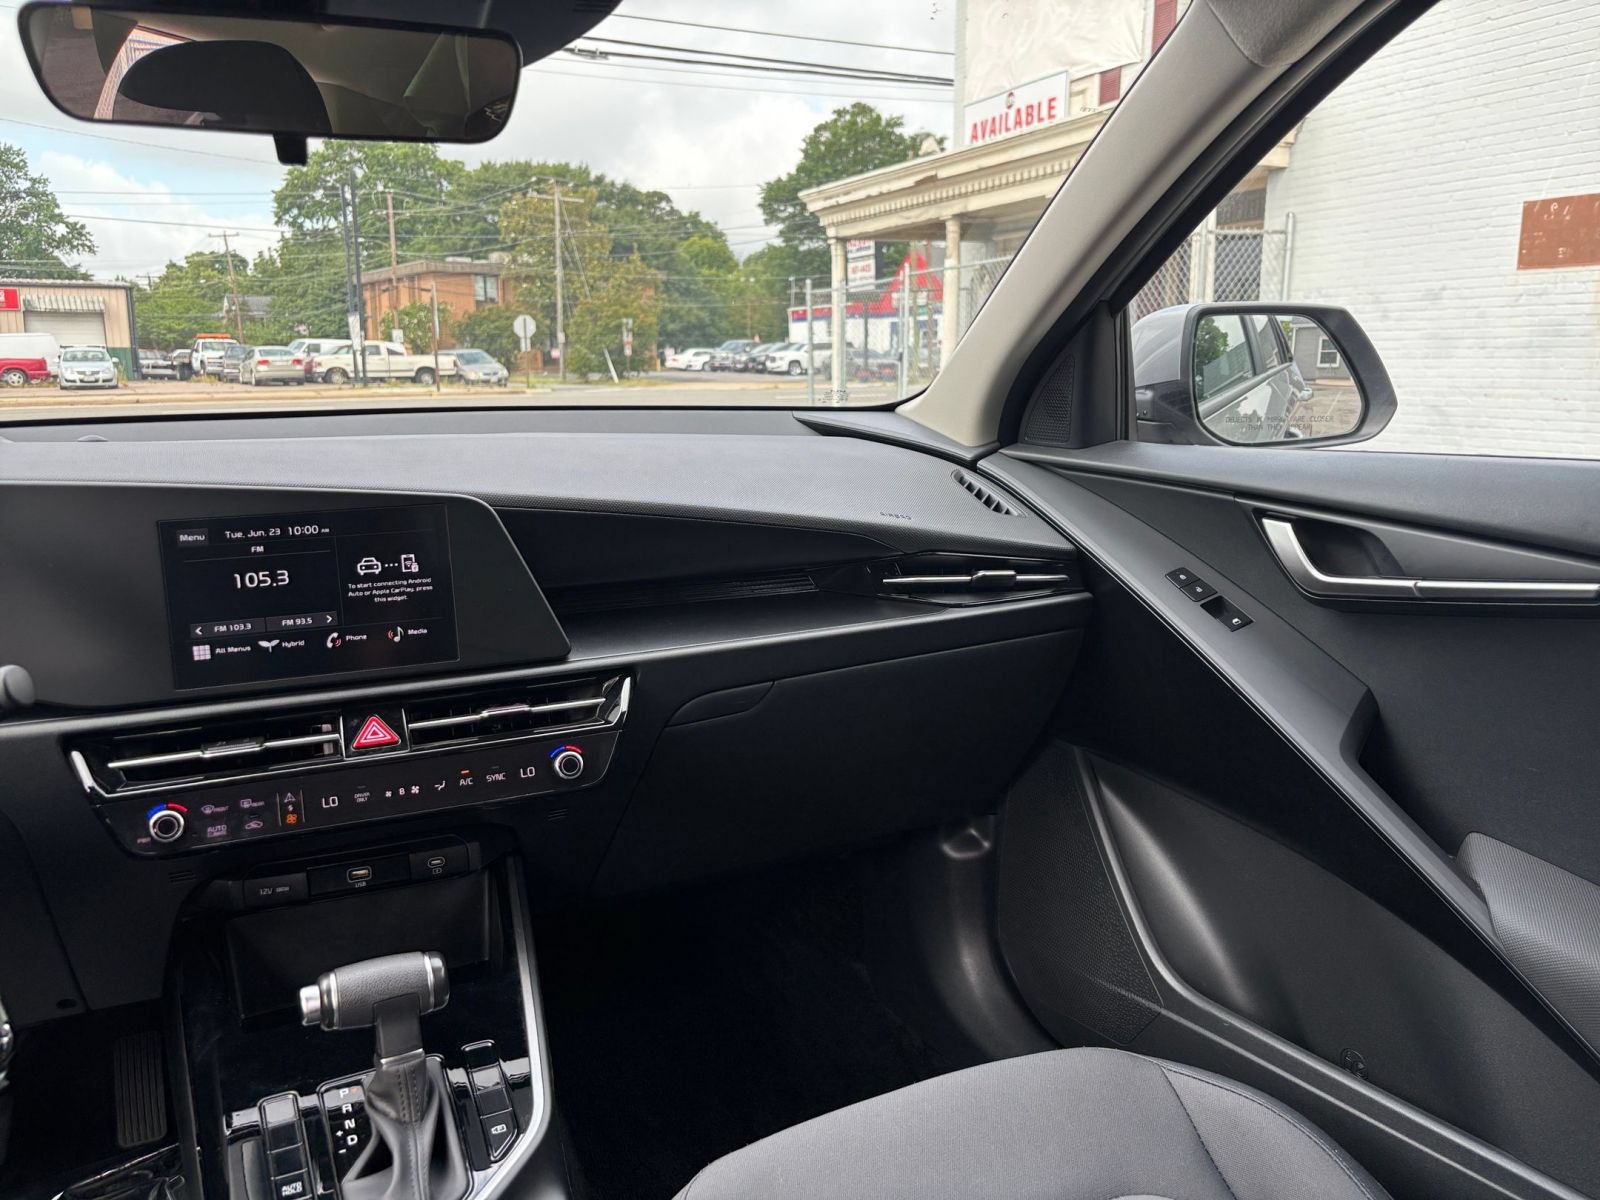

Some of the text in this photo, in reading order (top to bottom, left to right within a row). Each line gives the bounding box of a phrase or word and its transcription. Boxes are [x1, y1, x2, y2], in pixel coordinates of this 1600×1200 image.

[970, 97, 1057, 144] AVAILABLE
[224, 530, 246, 539] Tue.
[247, 529, 267, 538] Jun.
[268, 527, 281, 536] 23
[288, 525, 319, 535] 10:00
[179, 533, 206, 542] Menu
[251, 545, 265, 553] FM
[233, 570, 289, 589] 105.3
[373, 579, 408, 587] connecting
[372, 588, 390, 596] Apple
[295, 617, 313, 625] 93.5
[214, 623, 252, 633] FM 103.3
[227, 645, 251, 653] Menus
[282, 640, 305, 648] Hybrid
[485, 772, 507, 782] SYNC
[519, 766, 536, 778] LO
[459, 777, 474, 786] A/C
[321, 796, 339, 808] LO
[207, 824, 228, 832] AUTO
[259, 886, 273, 896] 12V
[340, 1088, 349, 1099] P
[342, 1103, 352, 1114] R
[344, 1118, 355, 1129] N
[347, 1134, 358, 1145] D
[281, 1181, 302, 1191] AUTO
[282, 1185, 303, 1197] HOLD
